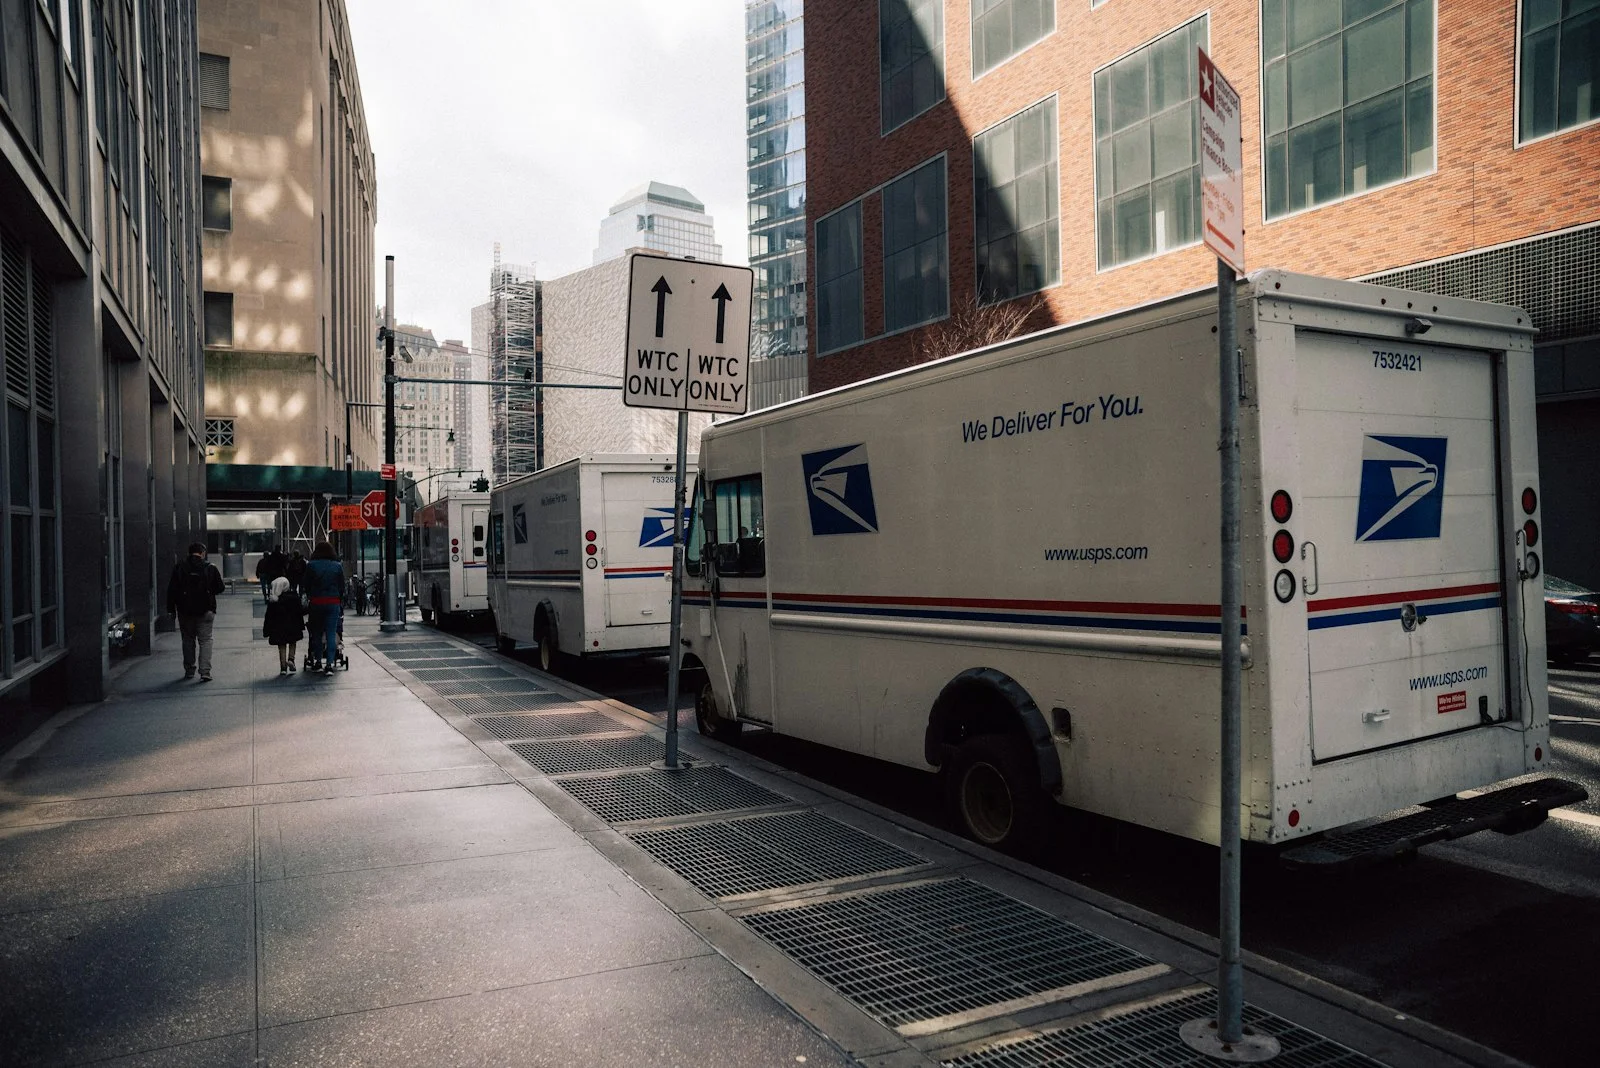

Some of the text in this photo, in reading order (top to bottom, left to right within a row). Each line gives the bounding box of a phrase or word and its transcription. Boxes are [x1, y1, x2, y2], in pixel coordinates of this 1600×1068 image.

[1202, 115, 1224, 154] Campaign
[1202, 136, 1235, 183] Finance Board
[638, 349, 679, 372] WTC
[699, 355, 739, 377] WTC
[1372, 351, 1422, 372] 7532421
[629, 375, 684, 397] ONLY
[690, 380, 744, 402] ONLY
[962, 394, 1144, 443] We Deliver For You.
[1044, 546, 1148, 564] www.usps.com
[1409, 665, 1488, 691] www.usps.com
